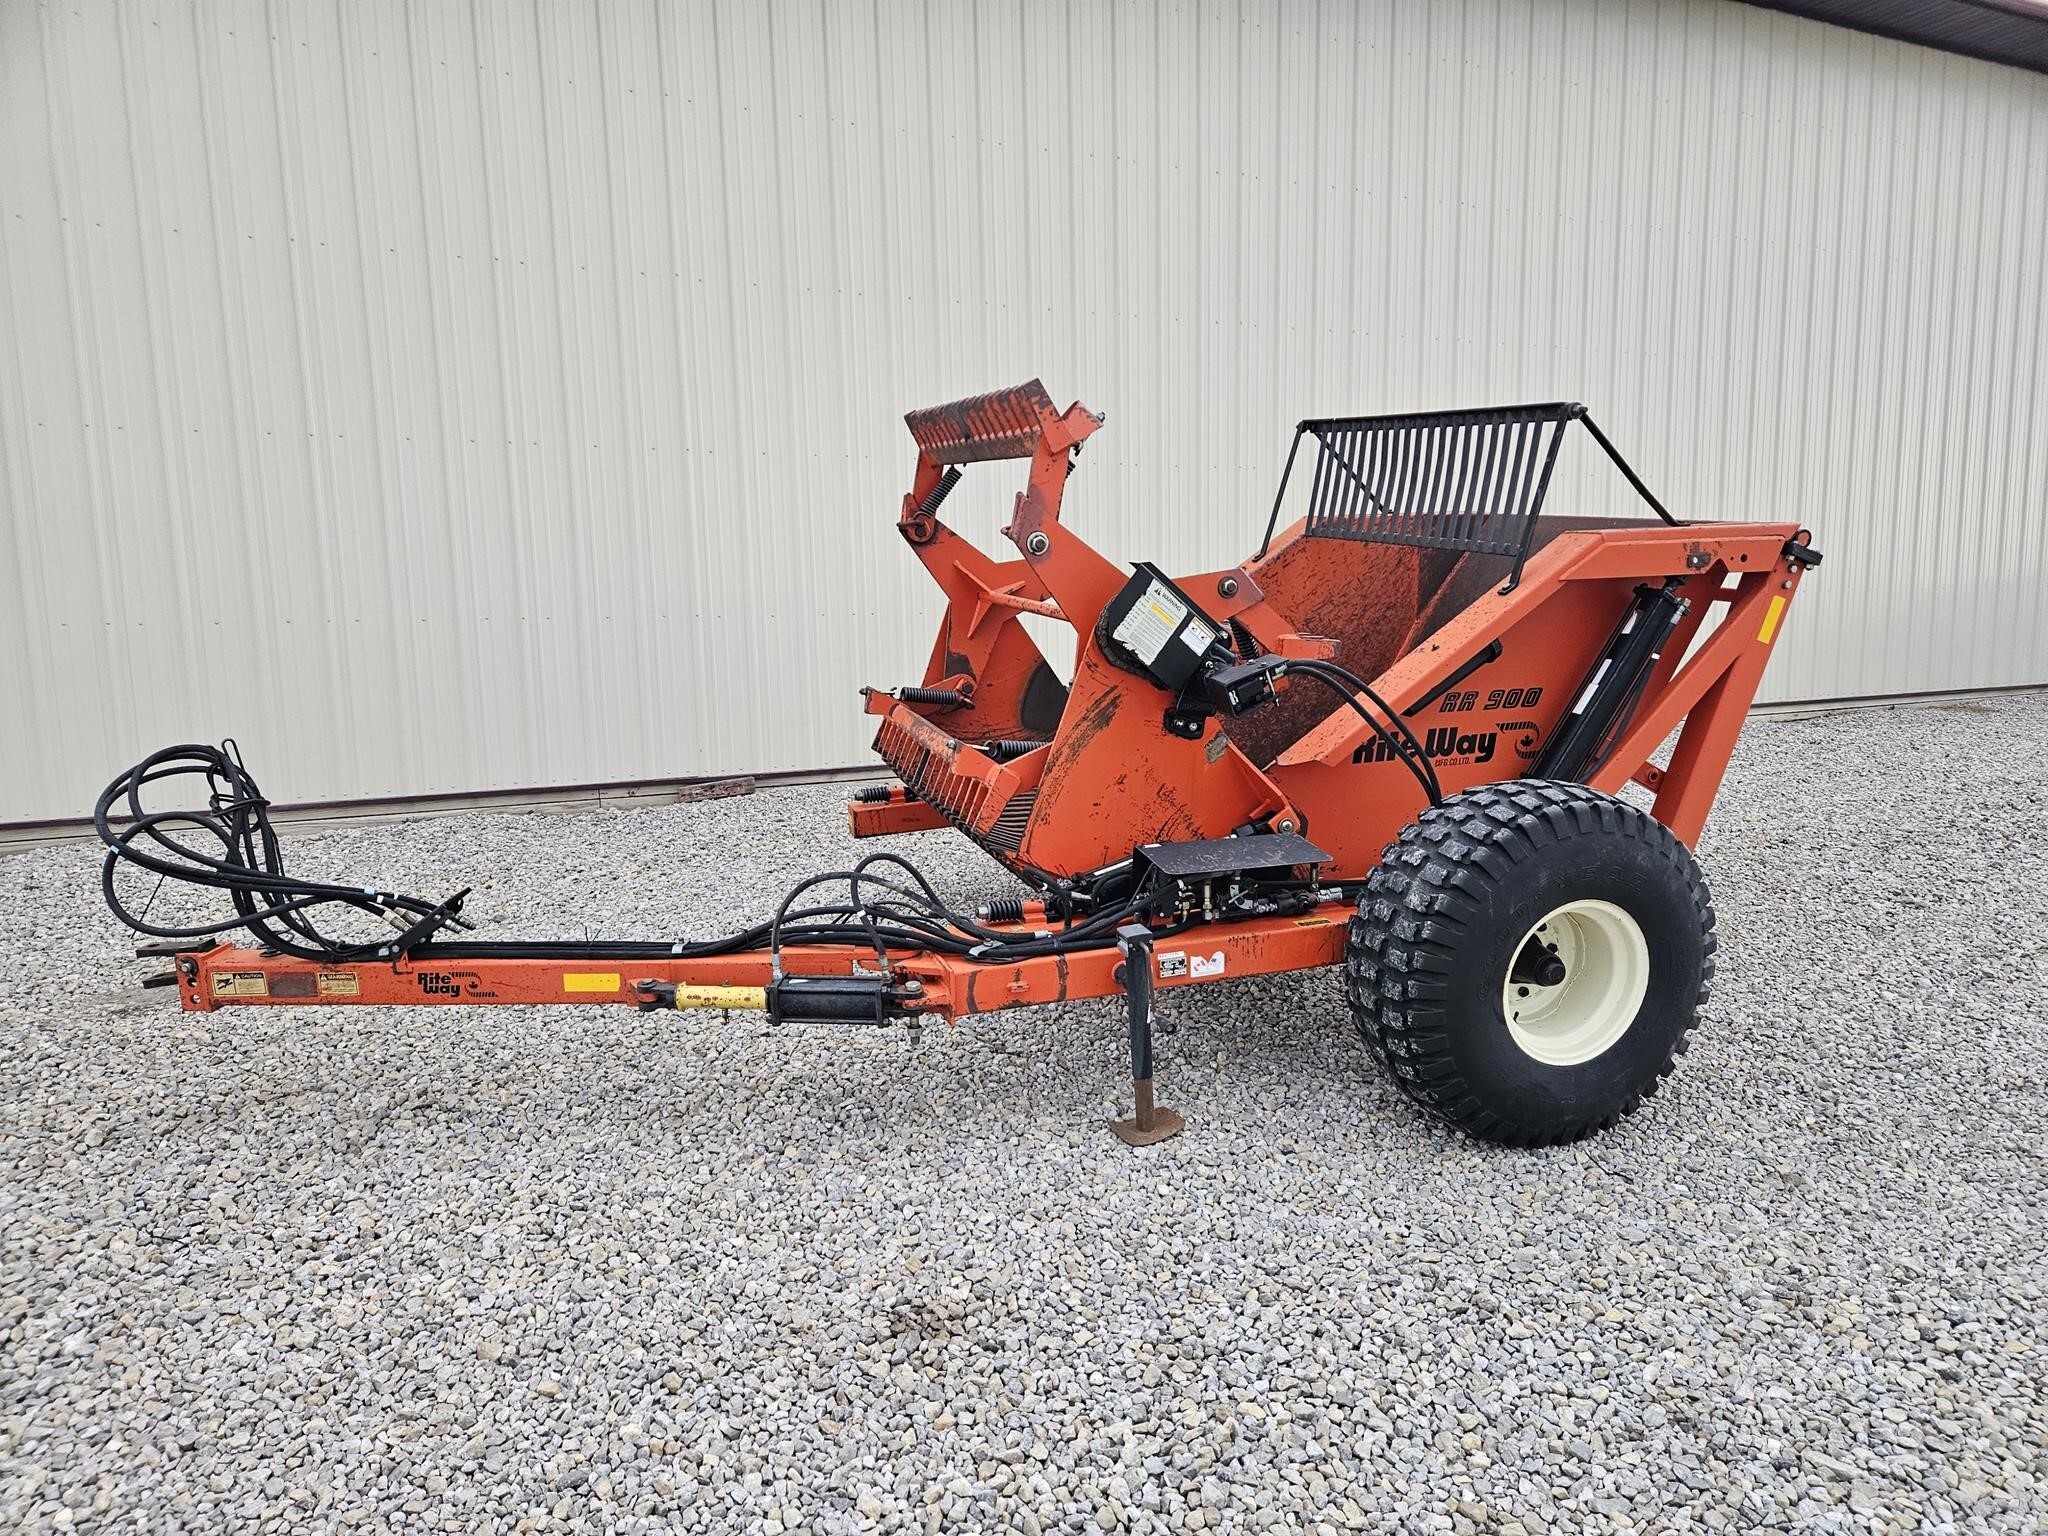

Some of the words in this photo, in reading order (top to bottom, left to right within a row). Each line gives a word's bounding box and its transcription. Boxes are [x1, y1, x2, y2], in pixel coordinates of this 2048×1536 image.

[1161, 592, 1182, 611] WARNING
[1439, 691, 1479, 712] RR
[1483, 687, 1544, 710] 900
[1425, 727, 1497, 763] Way
[417, 972, 452, 985] Rite
